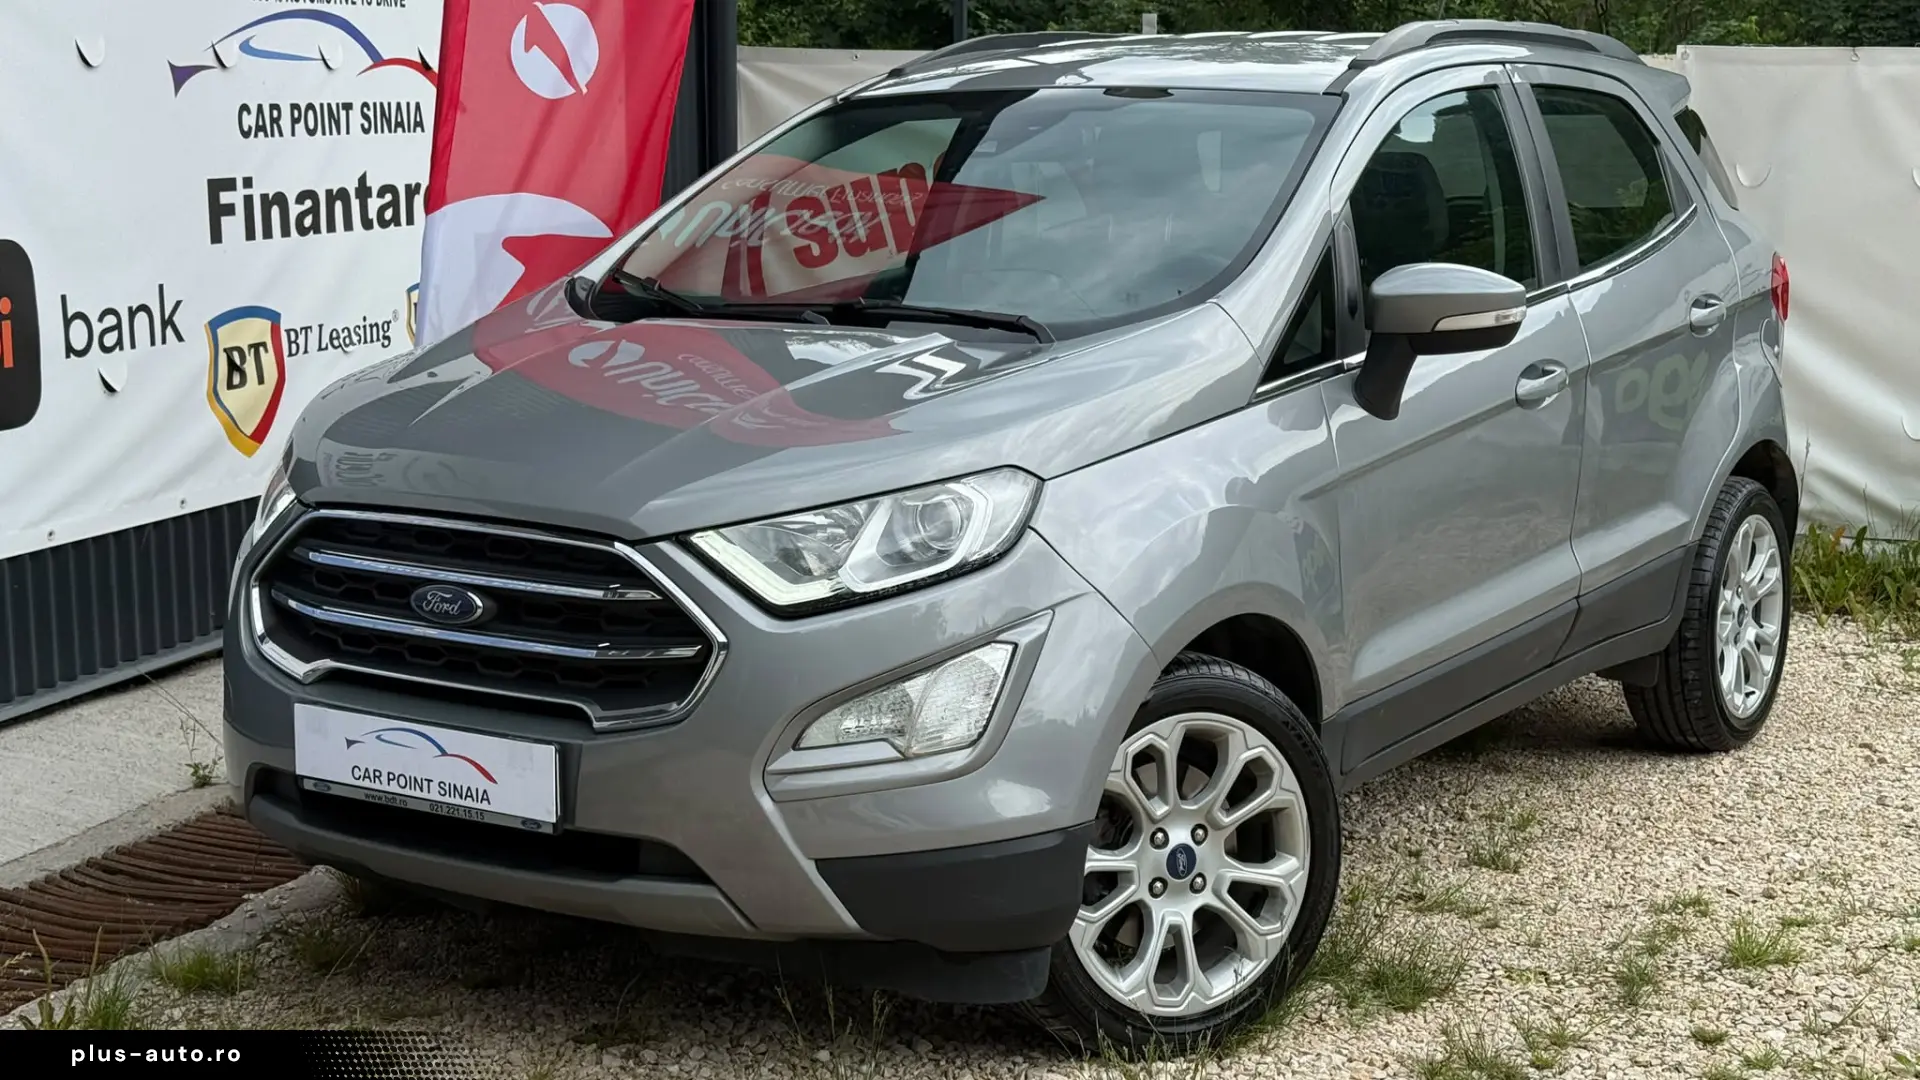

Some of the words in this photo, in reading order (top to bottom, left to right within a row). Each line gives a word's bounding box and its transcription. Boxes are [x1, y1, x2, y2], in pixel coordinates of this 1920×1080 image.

[238, 103, 284, 139] CAR
[290, 103, 354, 137] POINT
[360, 101, 426, 135] SINAIA
[206, 170, 430, 245] Finantar
[60, 283, 186, 360] bank
[284, 326, 313, 359] BT
[223, 341, 269, 391] BT
[422, 590, 462, 615] Ford
[351, 765, 383, 786] CAR
[387, 772, 434, 794] POINT
[437, 781, 492, 805] SINAIA
[429, 803, 485, 821] 021.221.15.15
